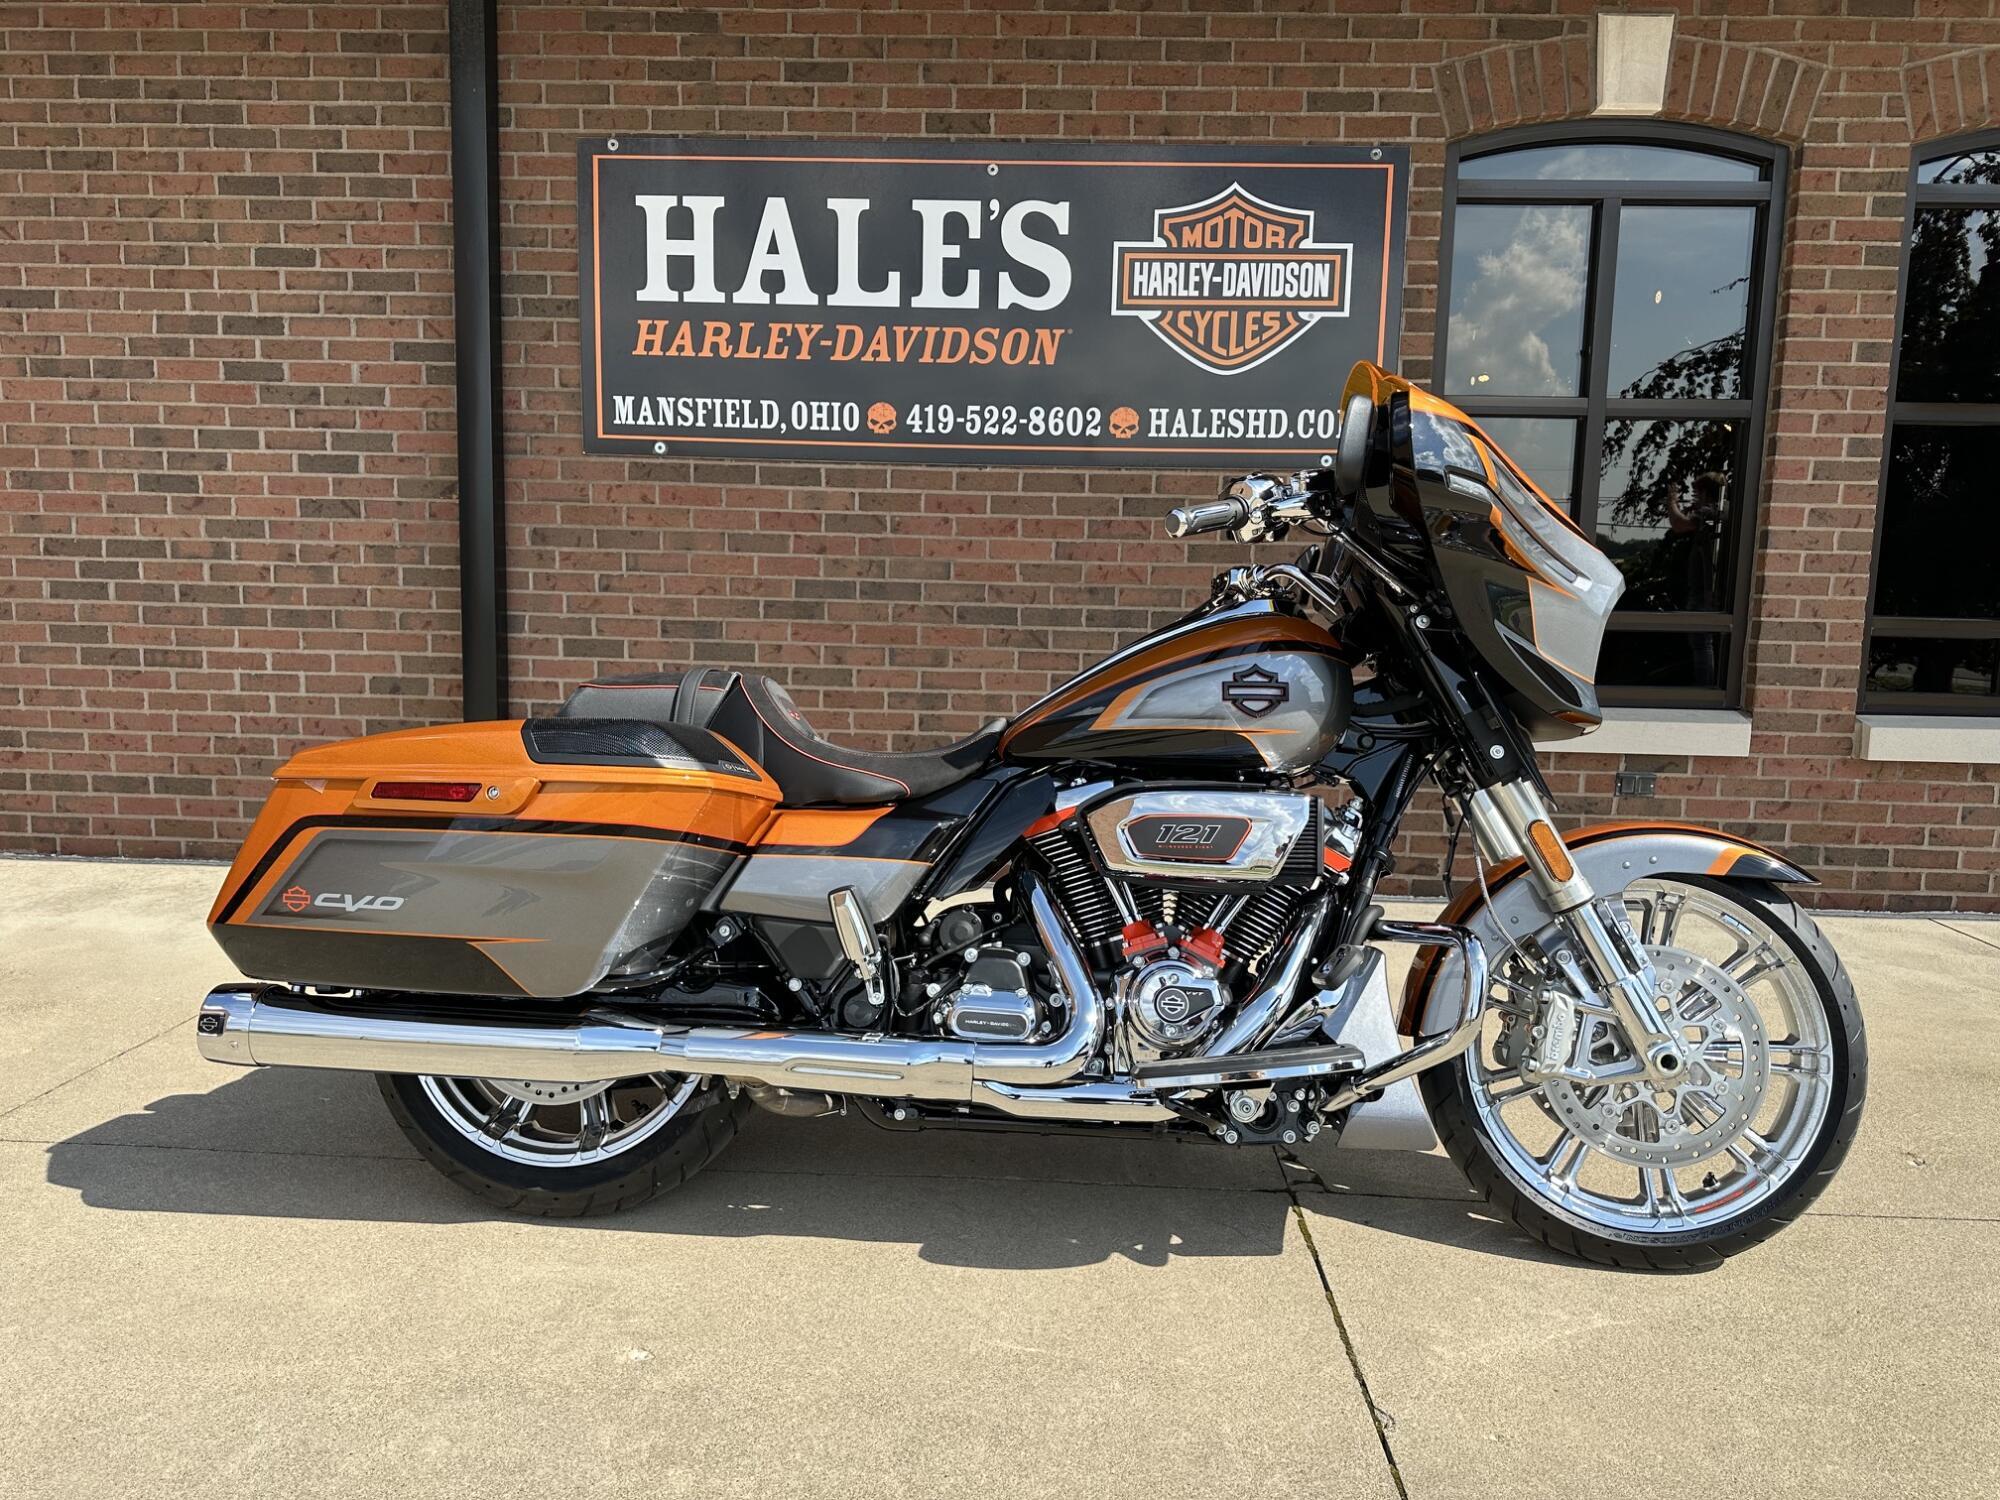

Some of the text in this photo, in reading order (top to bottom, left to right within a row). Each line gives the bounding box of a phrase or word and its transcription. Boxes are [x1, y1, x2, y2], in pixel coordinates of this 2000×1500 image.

[1181, 208, 1286, 249] MOTOR
[635, 195, 1072, 311] HALE'S
[1133, 261, 1331, 298] HARLEY-DAVIDSON
[632, 319, 1065, 365] HARLEY-DAVIDSON
[1176, 311, 1281, 357] CYCLES
[791, 401, 860, 431] OHIO
[906, 403, 1101, 437] 419-522-8602
[1148, 408, 1342, 439] HALESHD.CO
[1155, 824, 1222, 844] 121
[314, 893, 404, 912] CVO
